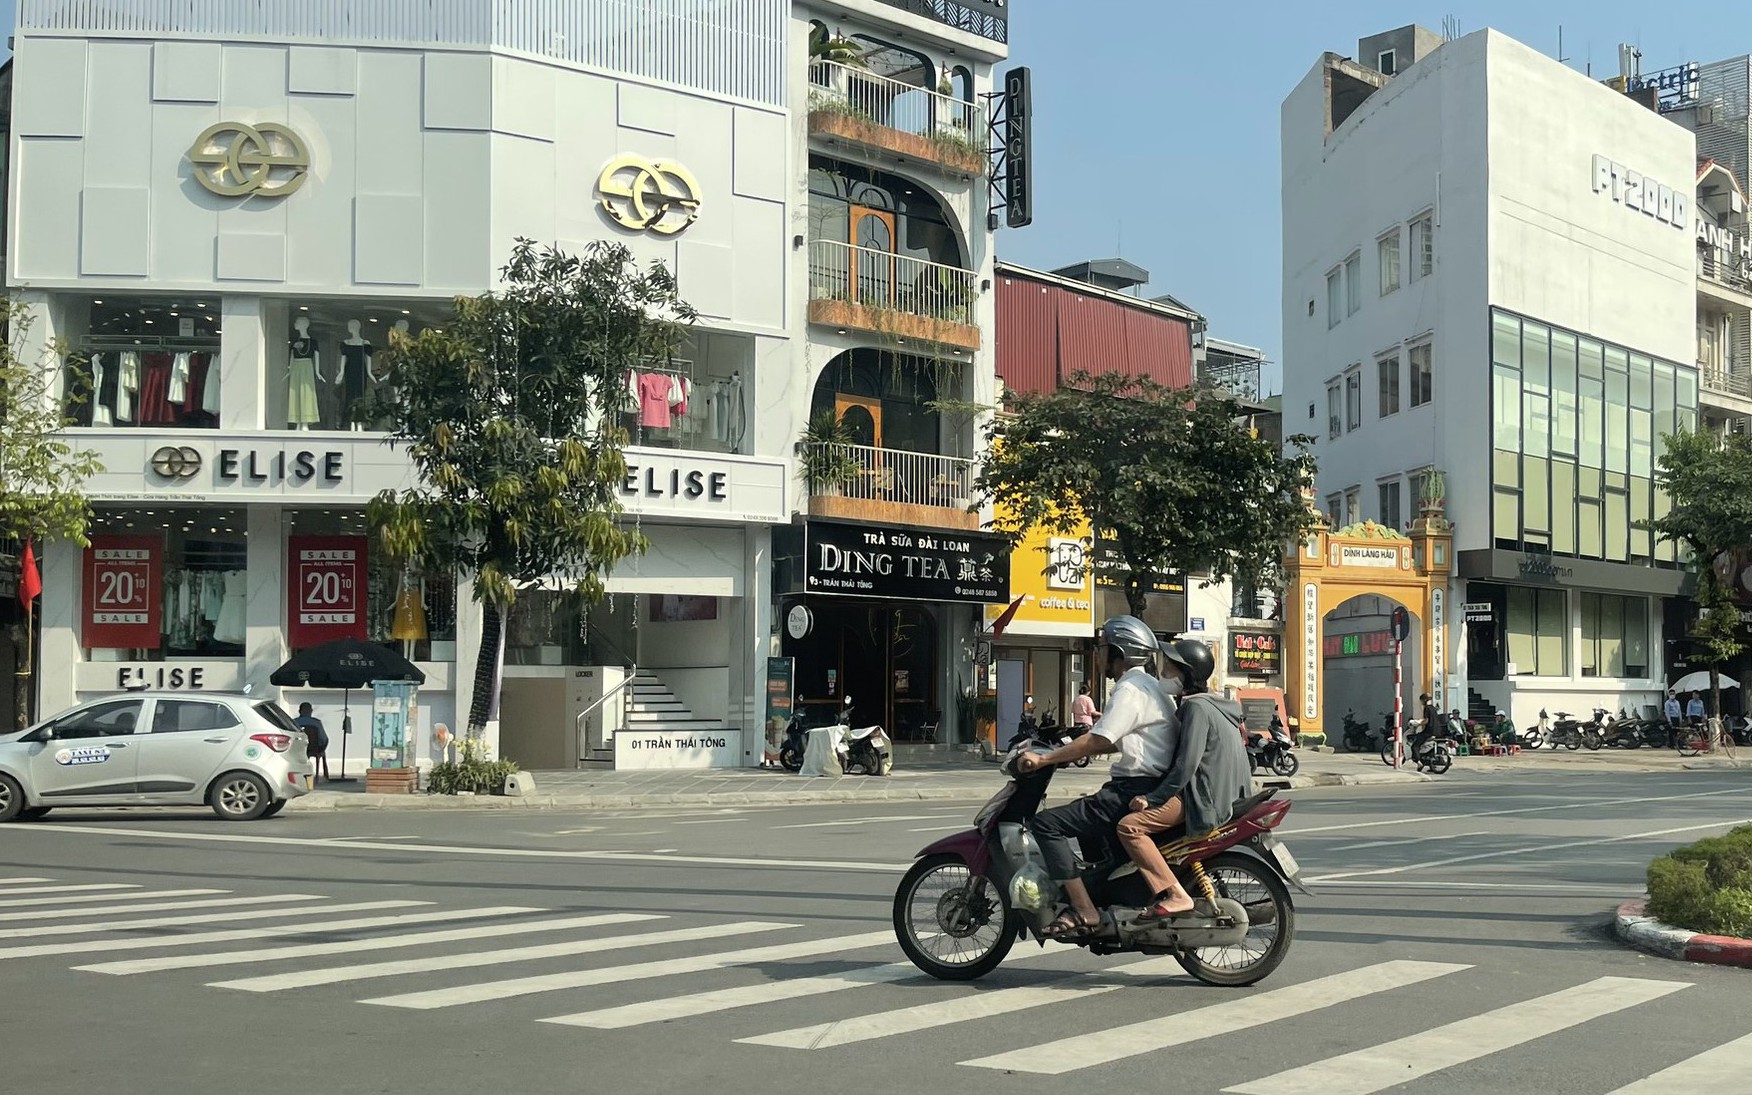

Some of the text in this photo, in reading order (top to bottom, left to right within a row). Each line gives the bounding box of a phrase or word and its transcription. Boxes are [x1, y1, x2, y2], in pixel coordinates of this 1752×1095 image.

[1591, 153, 1687, 229] PT2000
[220, 449, 344, 480] ELISE
[622, 465, 727, 499] ELISE
[307, 551, 349, 559] SALE
[863, 531, 970, 553] TRÀ SỮA ĐÀI LOAN
[818, 542, 951, 580] DING TEA
[100, 571, 133, 604] 20
[306, 571, 340, 604] 20
[1040, 596, 1066, 608] coffee
[101, 614, 142, 622] SALE
[632, 736, 726, 749] 01 TRẦN THÁI TÔNG
